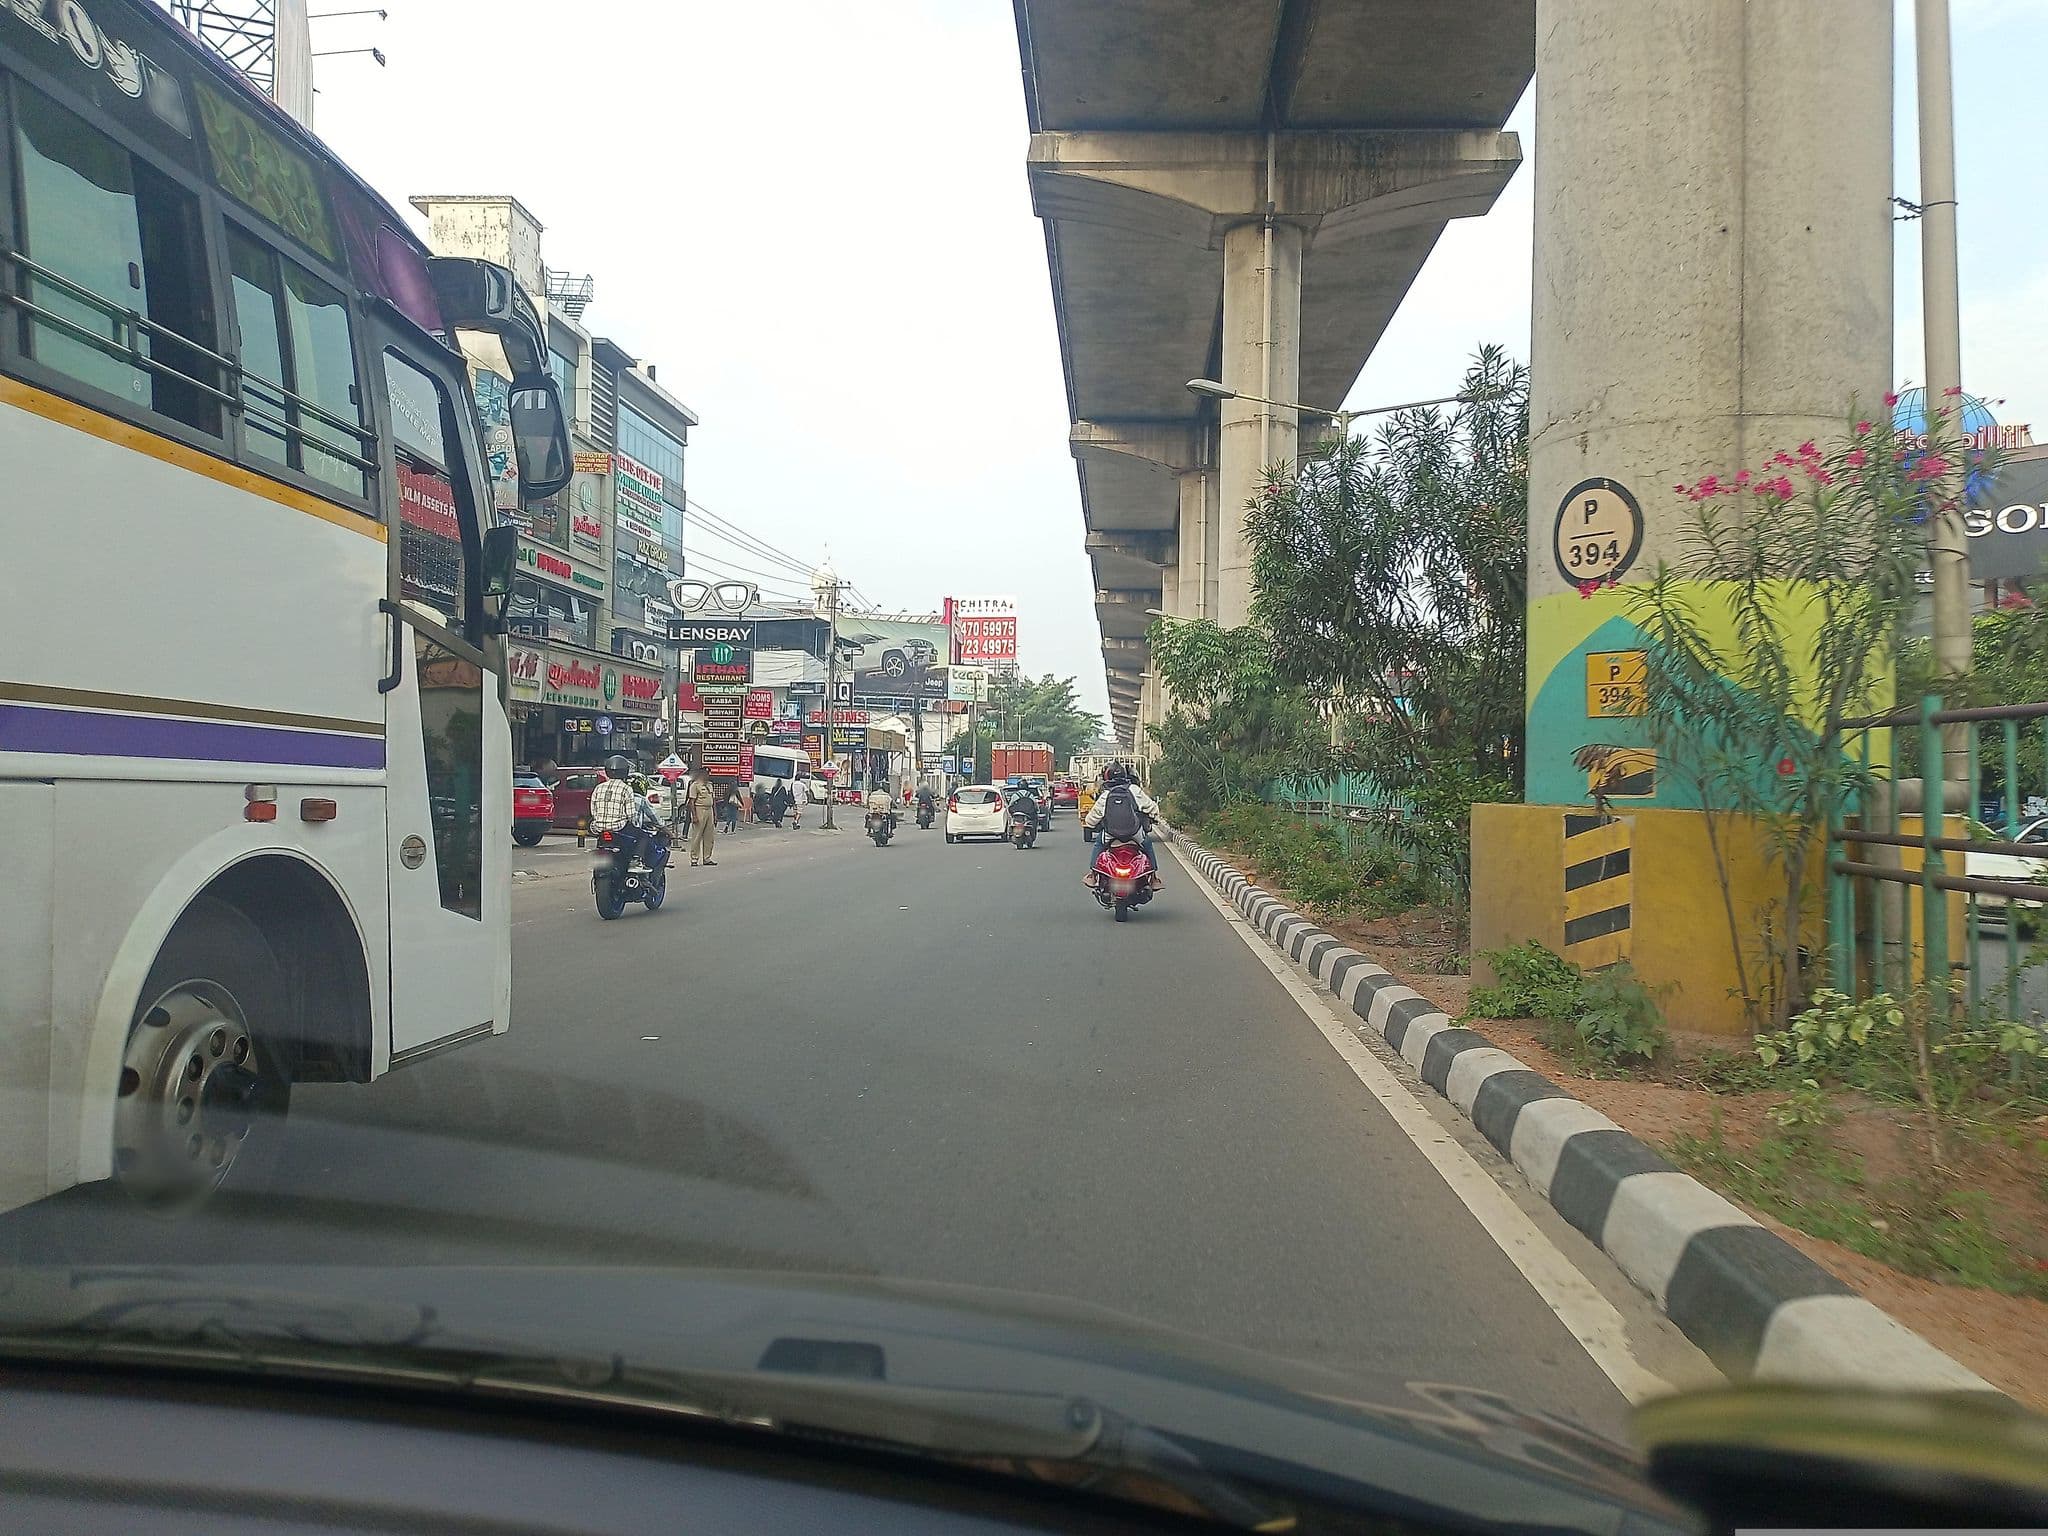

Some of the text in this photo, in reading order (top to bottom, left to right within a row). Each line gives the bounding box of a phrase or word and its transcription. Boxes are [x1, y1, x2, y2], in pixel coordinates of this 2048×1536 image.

[421, 494, 449, 516] ASSETS
[1584, 499, 1598, 524] P
[1569, 539, 1620, 567] 394
[960, 599, 1007, 608] CHITRA
[669, 627, 752, 641] LENSBAY
[982, 621, 1015, 637] 59975
[982, 639, 1015, 655] 49975
[1608, 666, 1621, 682] P
[925, 677, 944, 688] Jeep
